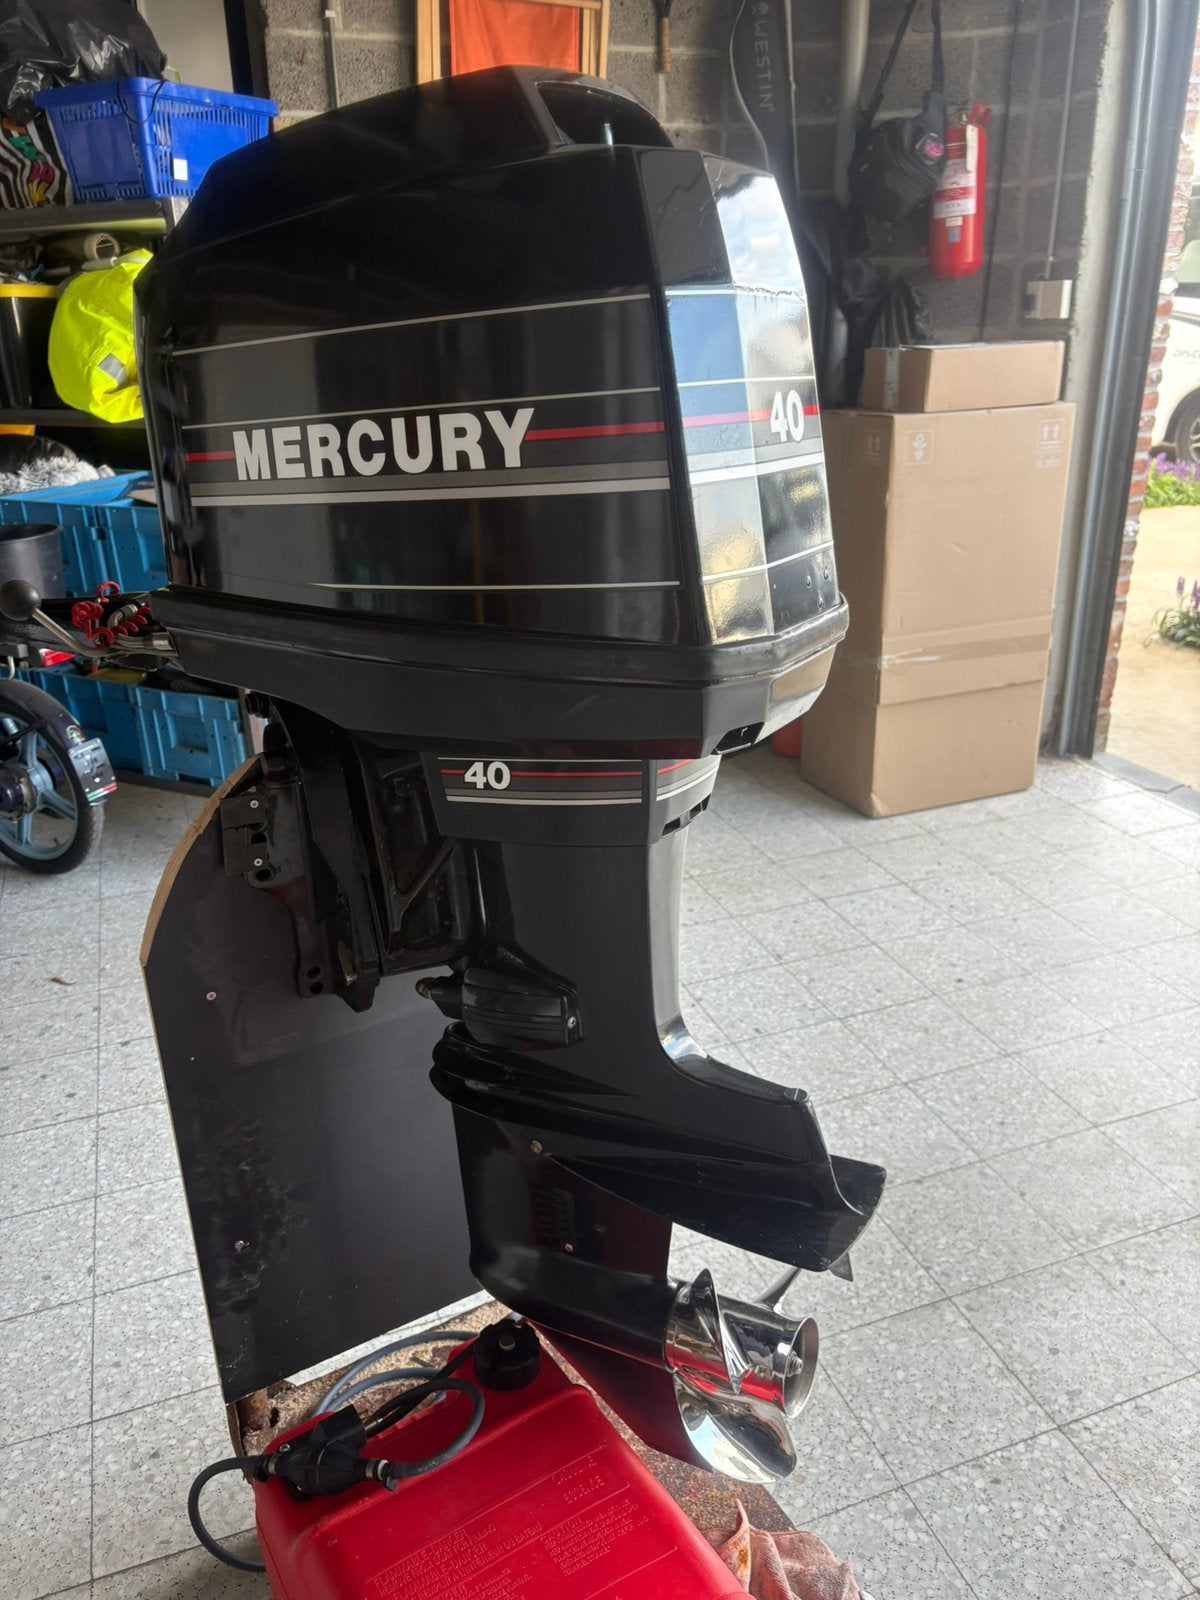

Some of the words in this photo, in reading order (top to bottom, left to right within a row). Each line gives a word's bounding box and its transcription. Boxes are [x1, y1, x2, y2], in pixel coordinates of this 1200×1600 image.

[754, 19, 772, 108] WESTIN
[770, 389, 804, 443] 40
[232, 407, 536, 481] MERCURY
[464, 761, 511, 790] 40
[562, 1474, 605, 1504] ESSENCE
[410, 1560, 433, 1578] FROM
[452, 1538, 470, 1554] FOR
